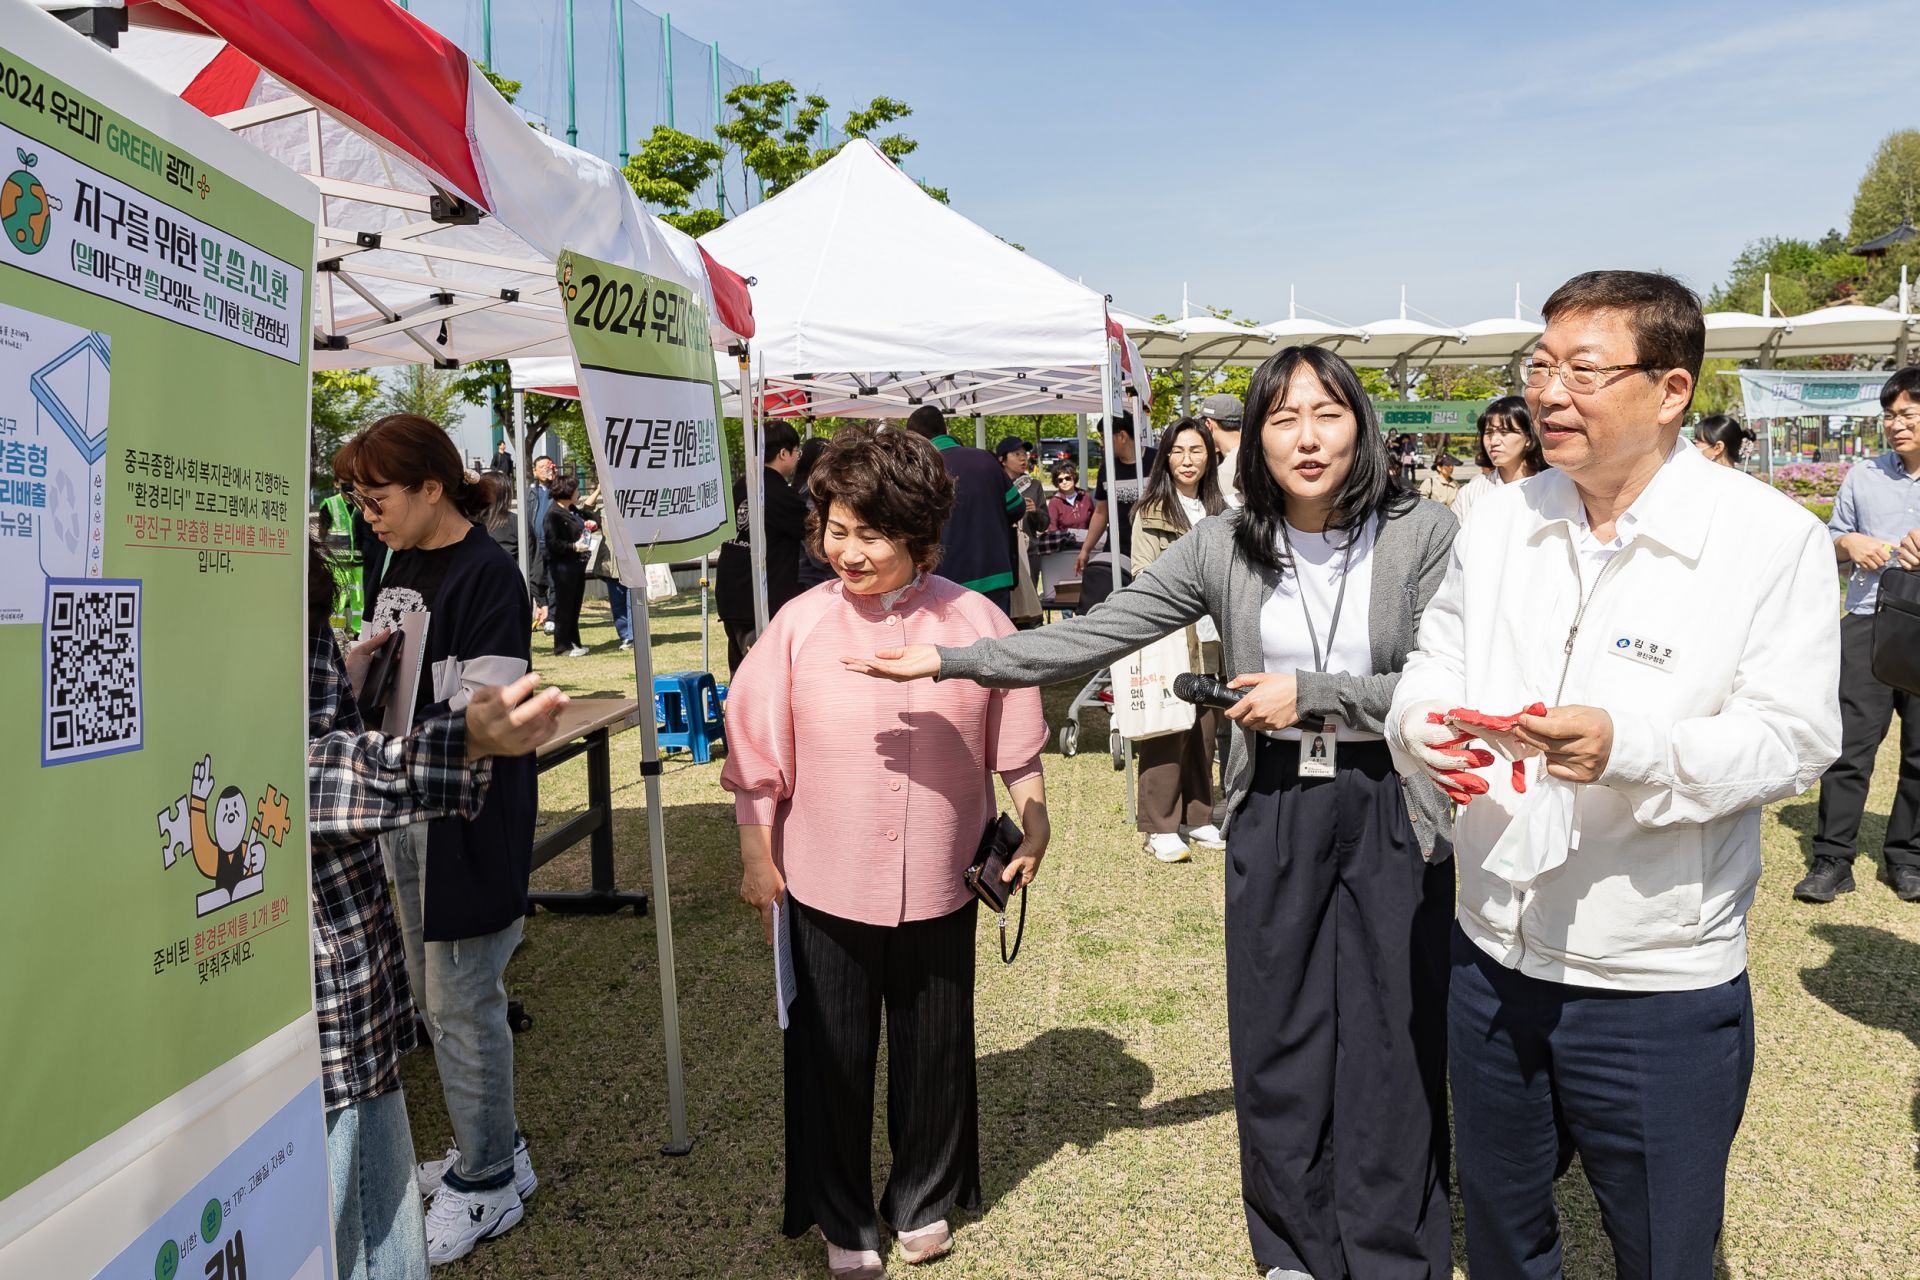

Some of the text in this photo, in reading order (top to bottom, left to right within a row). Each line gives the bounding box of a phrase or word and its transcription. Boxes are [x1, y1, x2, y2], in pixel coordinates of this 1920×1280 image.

[106, 123, 163, 176] GREEN
[166, 152, 194, 194] 광진
[73, 178, 150, 254] 지구를
[154, 216, 198, 273] 위한
[71, 238, 290, 348] (알아두면 쓸모있는 신기한 환경정보)
[573, 274, 648, 338] 2024
[1384, 411, 1432, 424] GREEN
[604, 416, 672, 469] 지구를
[672, 419, 697, 468] 위한
[124, 448, 290, 496] 중곡종합사회복지관에서 진행하는
[127, 481, 288, 522] "환경리더" 프로그램에서 제작한
[614, 488, 659, 519] 아두면
[657, 485, 696, 518] 쓸모있는
[126, 514, 290, 549] "광진구 맞춤형 분리배출 매뉴얼"
[198, 550, 234, 573] 입니다.
[153, 896, 289, 975] 준비된 환경문제를 1개 뽑아
[197, 940, 256, 985] 맞춰주세요.
